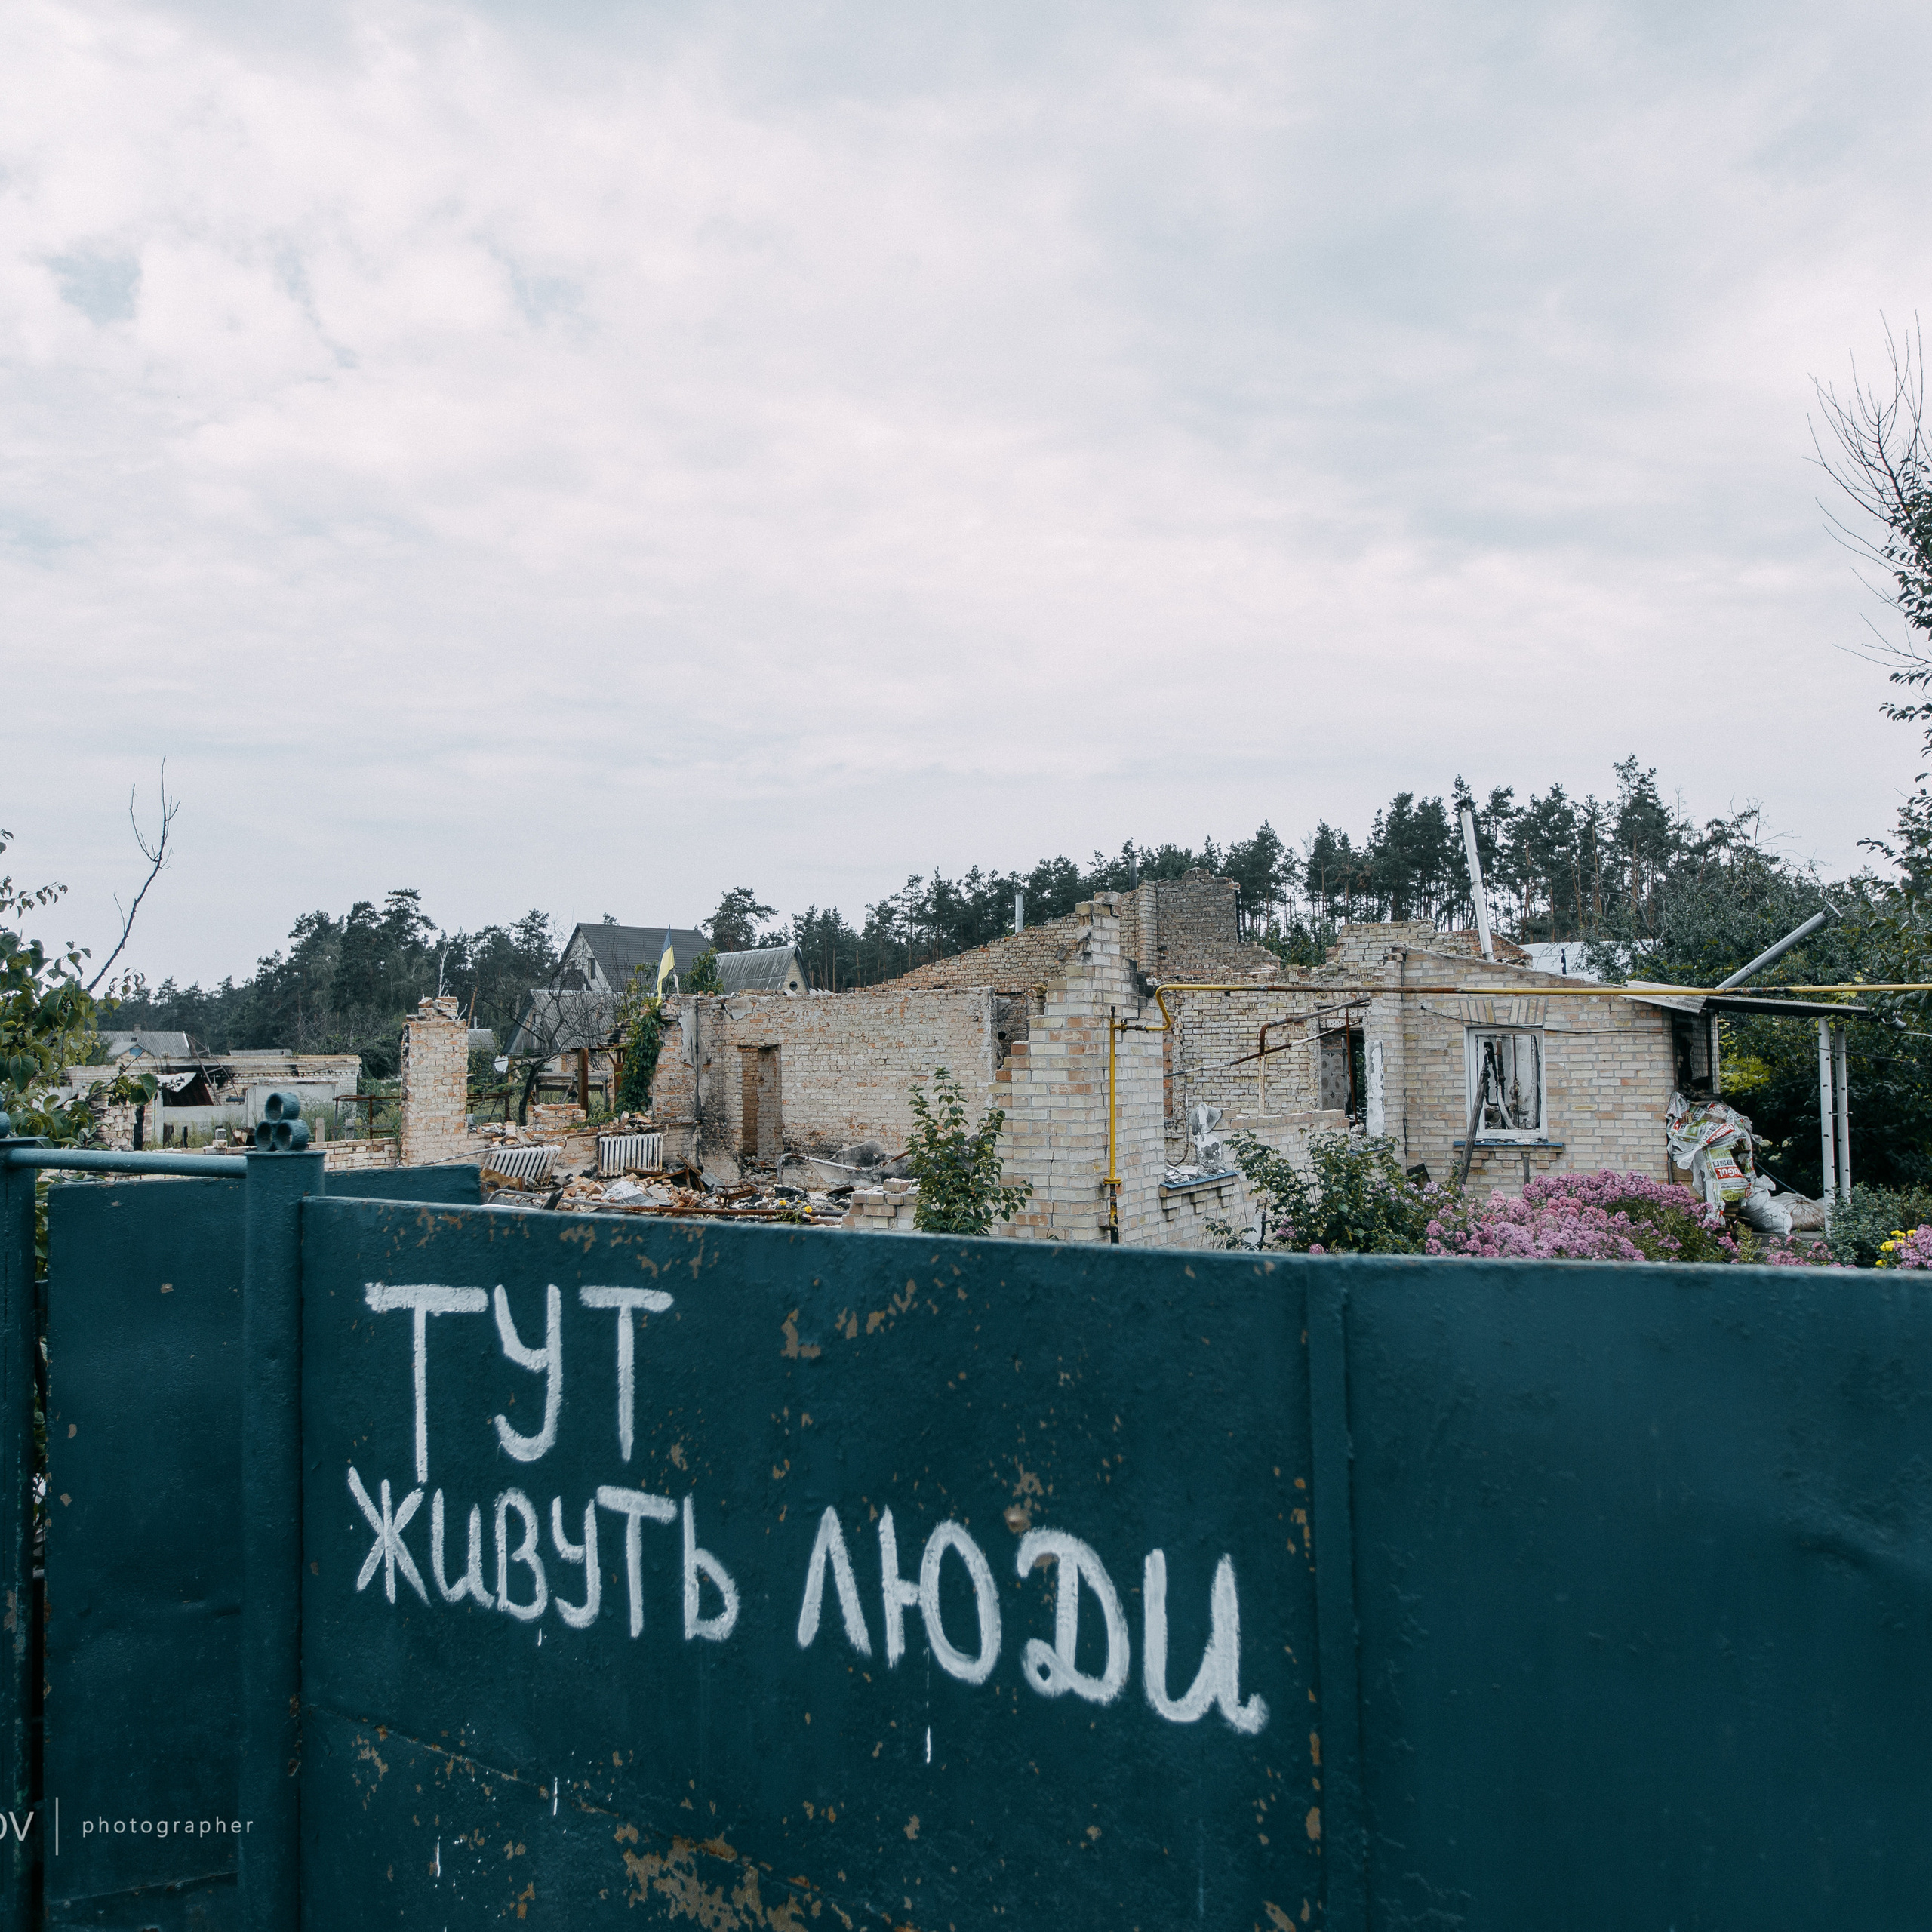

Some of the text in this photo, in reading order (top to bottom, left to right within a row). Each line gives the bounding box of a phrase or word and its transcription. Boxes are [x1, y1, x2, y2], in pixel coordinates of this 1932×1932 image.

[365, 1281, 674, 1484] ТУТ
[347, 1466, 1268, 1734] ЖИВУТЬ ЛЮДИ
